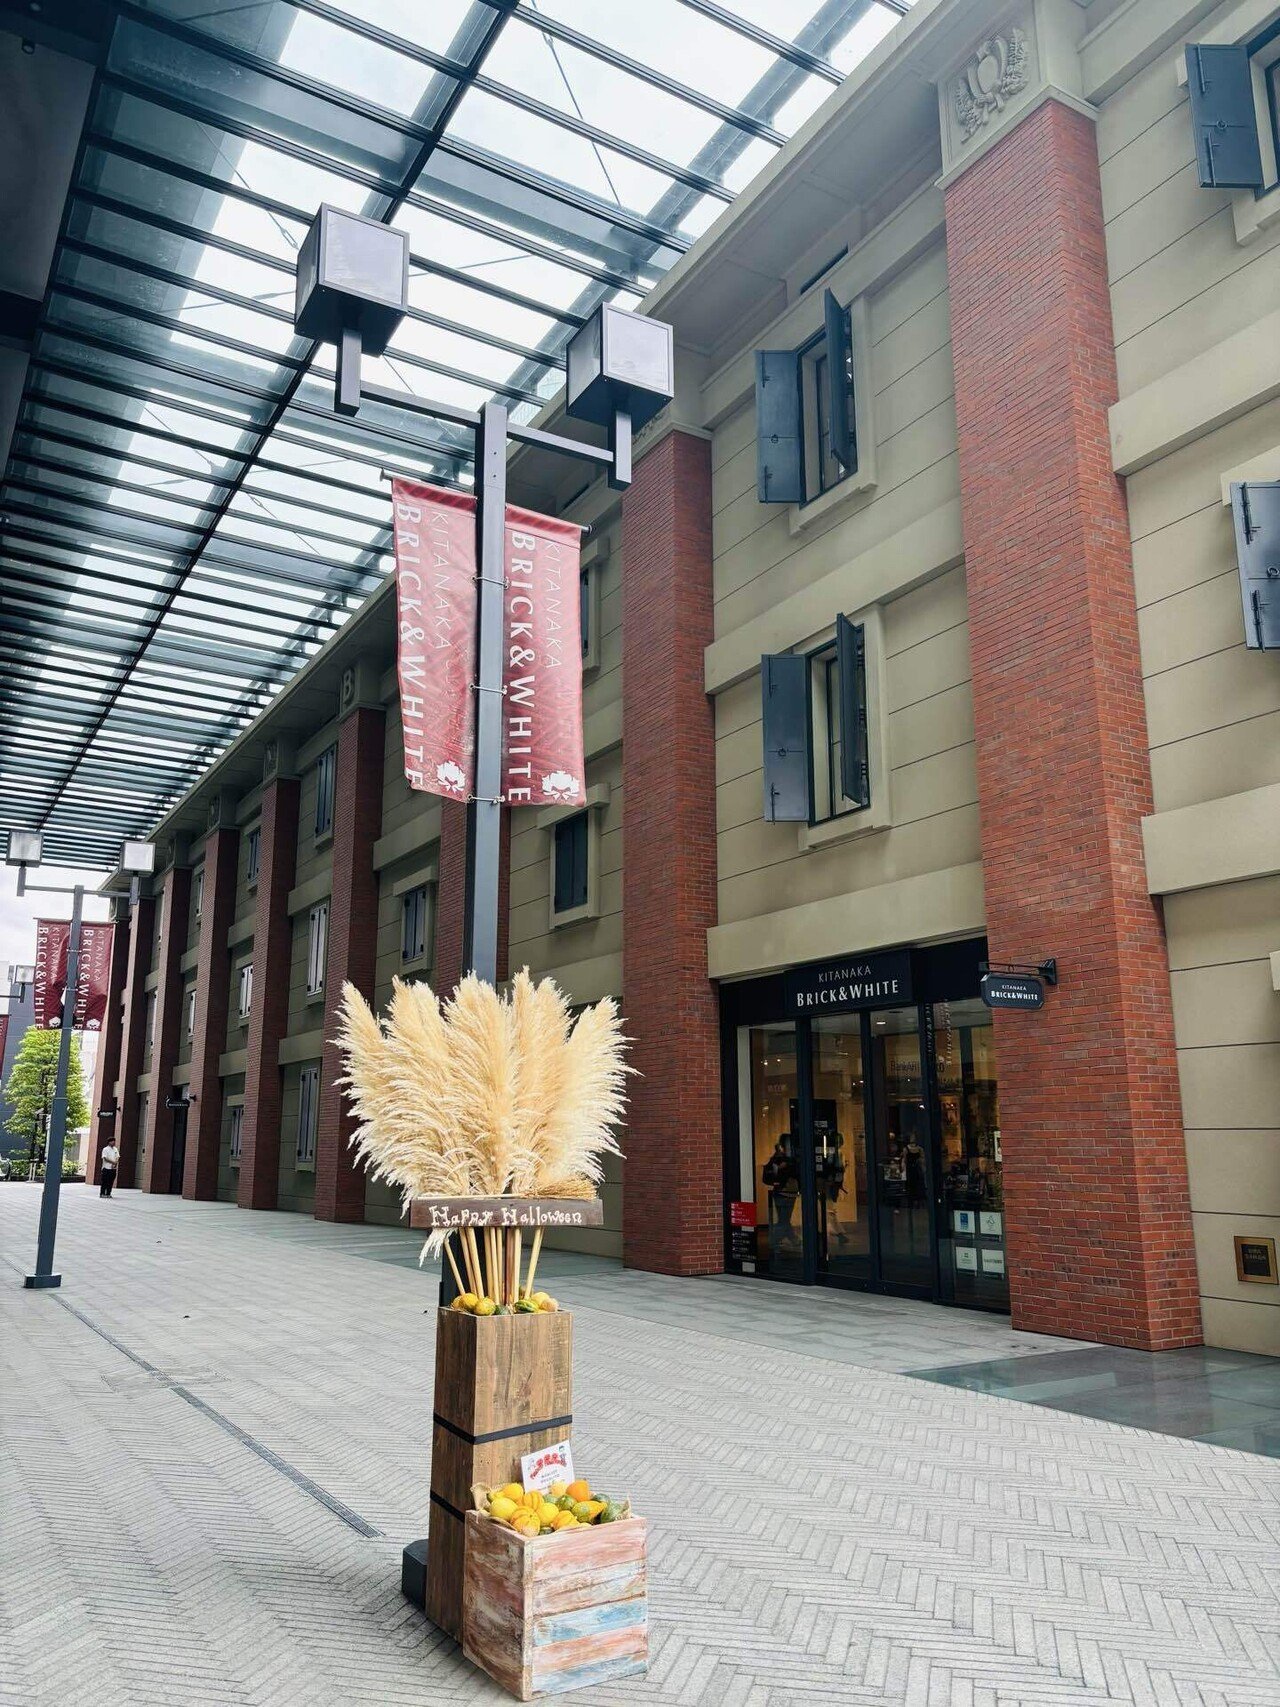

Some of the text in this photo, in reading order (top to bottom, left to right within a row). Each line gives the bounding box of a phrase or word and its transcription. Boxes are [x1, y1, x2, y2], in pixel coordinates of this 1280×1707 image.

[431, 510, 452, 650] KITANAKA
[544, 540, 562, 669] KITANAKA
[397, 502, 427, 787] BRICK&WHITE
[508, 531, 536, 802] BRICK&WHITE
[35, 926, 49, 1029] BRICK&WHITE
[49, 927, 60, 983] KITANAKA
[75, 929, 95, 1029] BRICK&WHITE
[94, 930, 106, 982] KITANAKA
[797, 979, 899, 1007] BRICK&WHITE
[818, 965, 872, 983] KITANAKA
[990, 990, 1038, 1001] BRICK&WHITE
[429, 1205, 582, 1226] Happy Halloween
